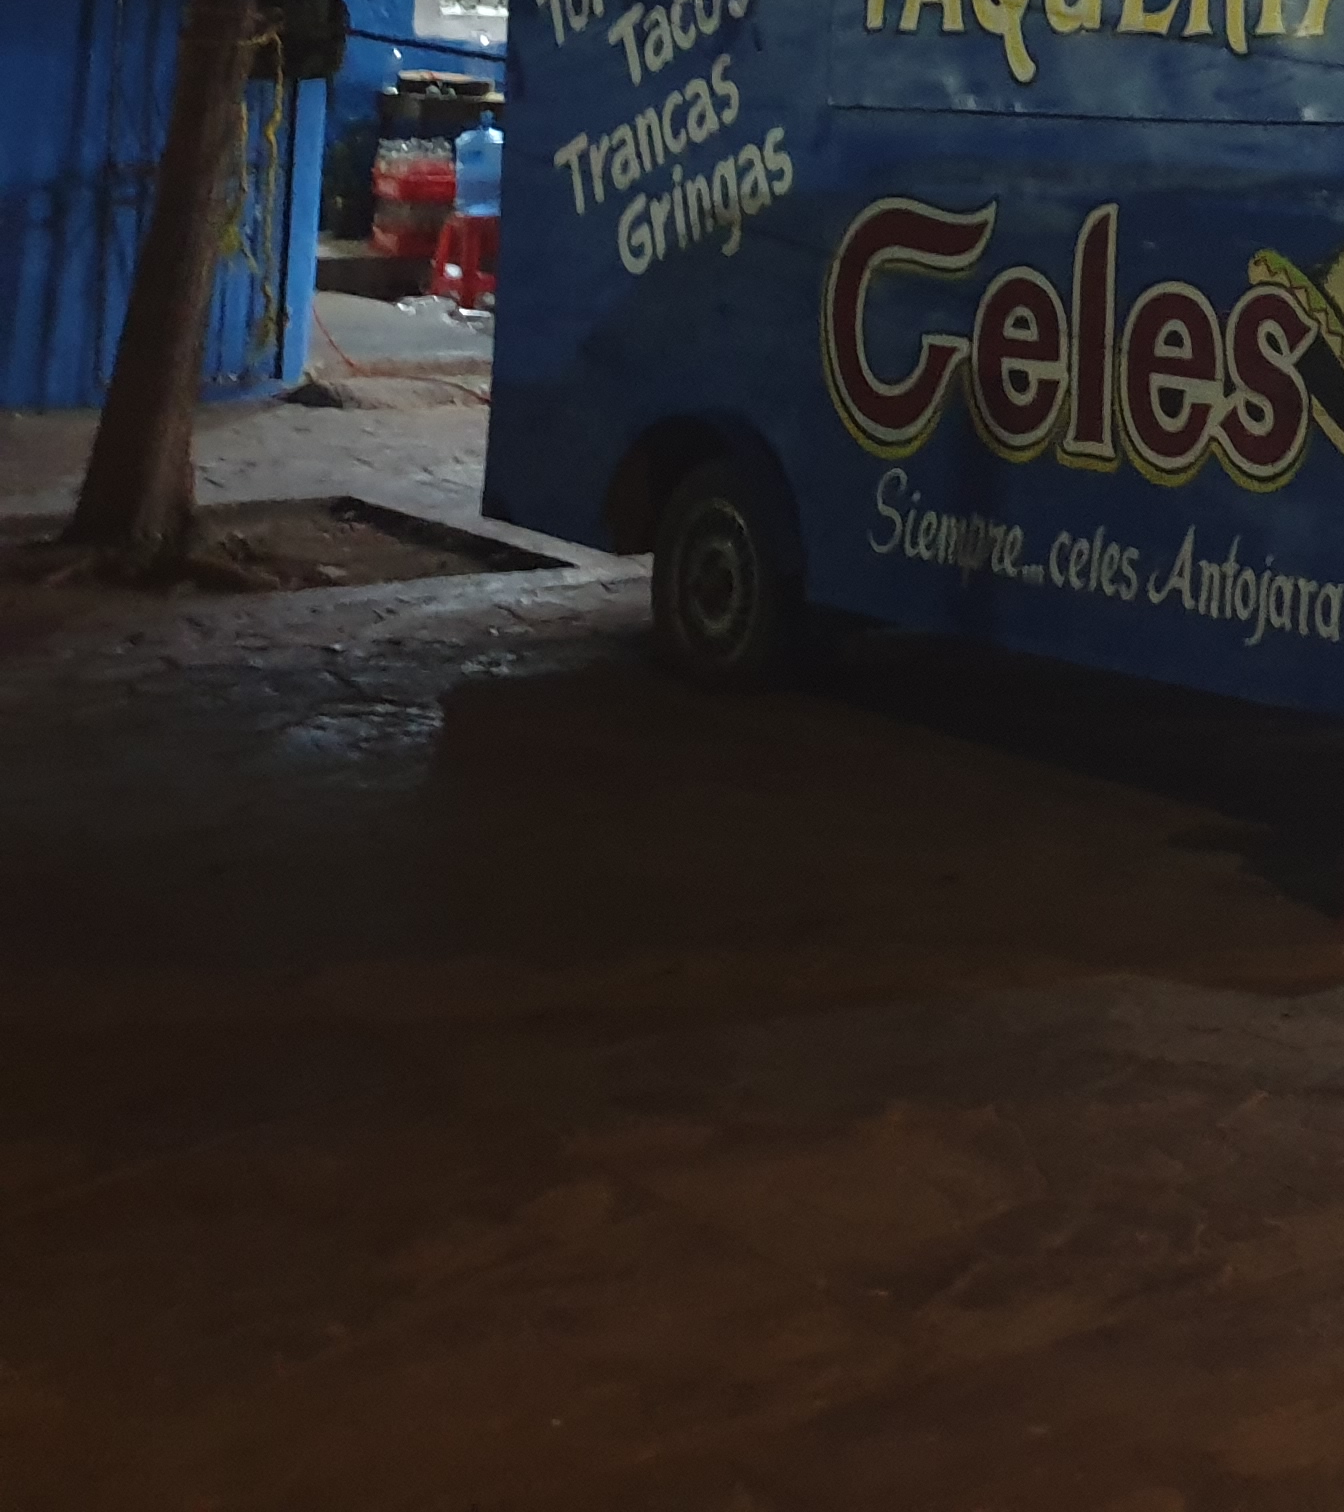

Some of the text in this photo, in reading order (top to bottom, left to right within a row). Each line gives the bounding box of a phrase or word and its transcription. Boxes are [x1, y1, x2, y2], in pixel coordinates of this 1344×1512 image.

[553, 53, 740, 216] Trancas
[617, 126, 794, 276] Gringas
[819, 195, 1320, 494] Celes
[1048, 525, 1140, 602] celes
[1147, 523, 1344, 649] Antojara
